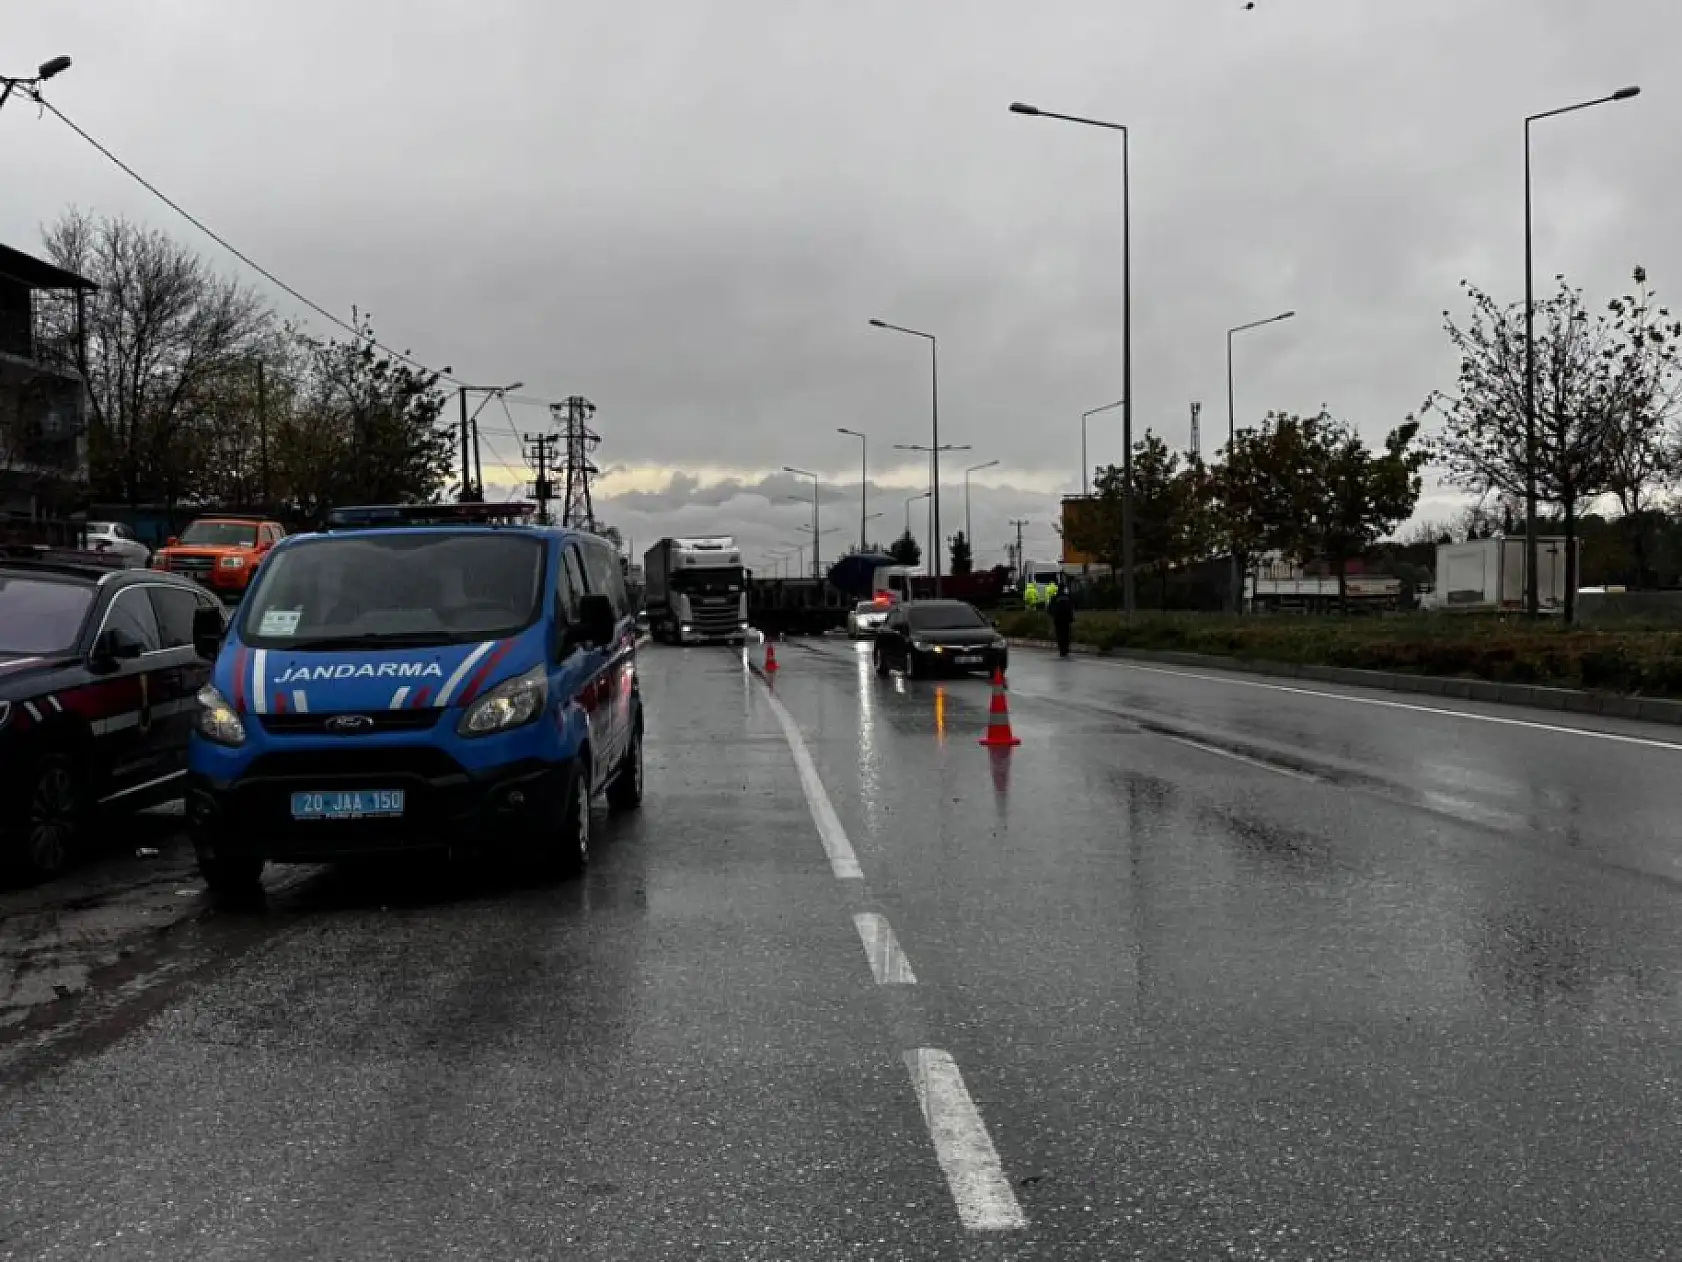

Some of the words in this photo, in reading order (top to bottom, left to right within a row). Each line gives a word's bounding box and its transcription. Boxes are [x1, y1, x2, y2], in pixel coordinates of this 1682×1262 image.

[274, 661, 442, 683] JANDARMA
[304, 794, 323, 812] 20
[332, 793, 361, 811] JAA
[374, 791, 400, 809] 150
